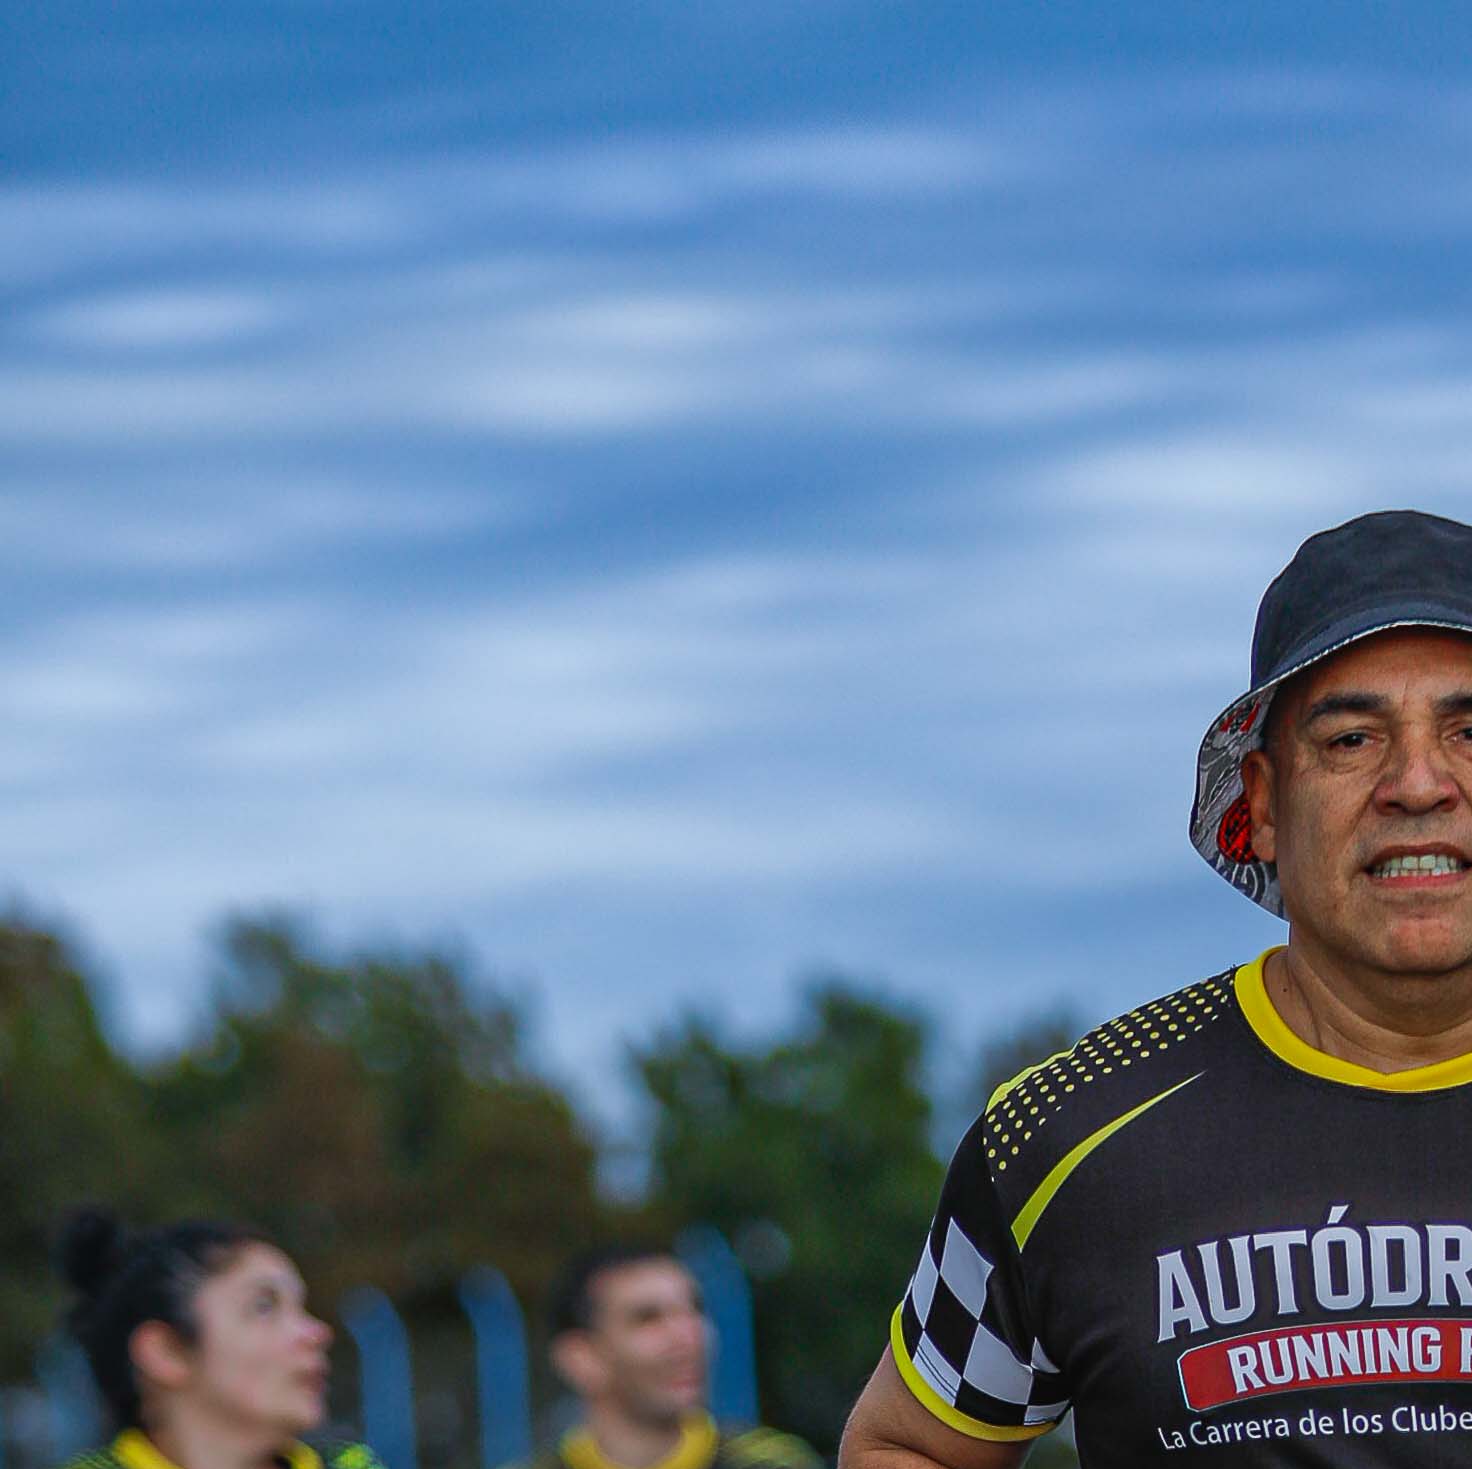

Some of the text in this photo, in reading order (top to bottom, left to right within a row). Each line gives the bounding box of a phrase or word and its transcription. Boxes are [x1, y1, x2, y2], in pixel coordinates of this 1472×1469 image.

[1227, 1327, 1442, 1394] RUNNING
[1157, 1426, 1187, 1450] La
[1190, 1409, 1290, 1446] Carrera
[1298, 1408, 1335, 1437] de
[1341, 1406, 1384, 1435] los
